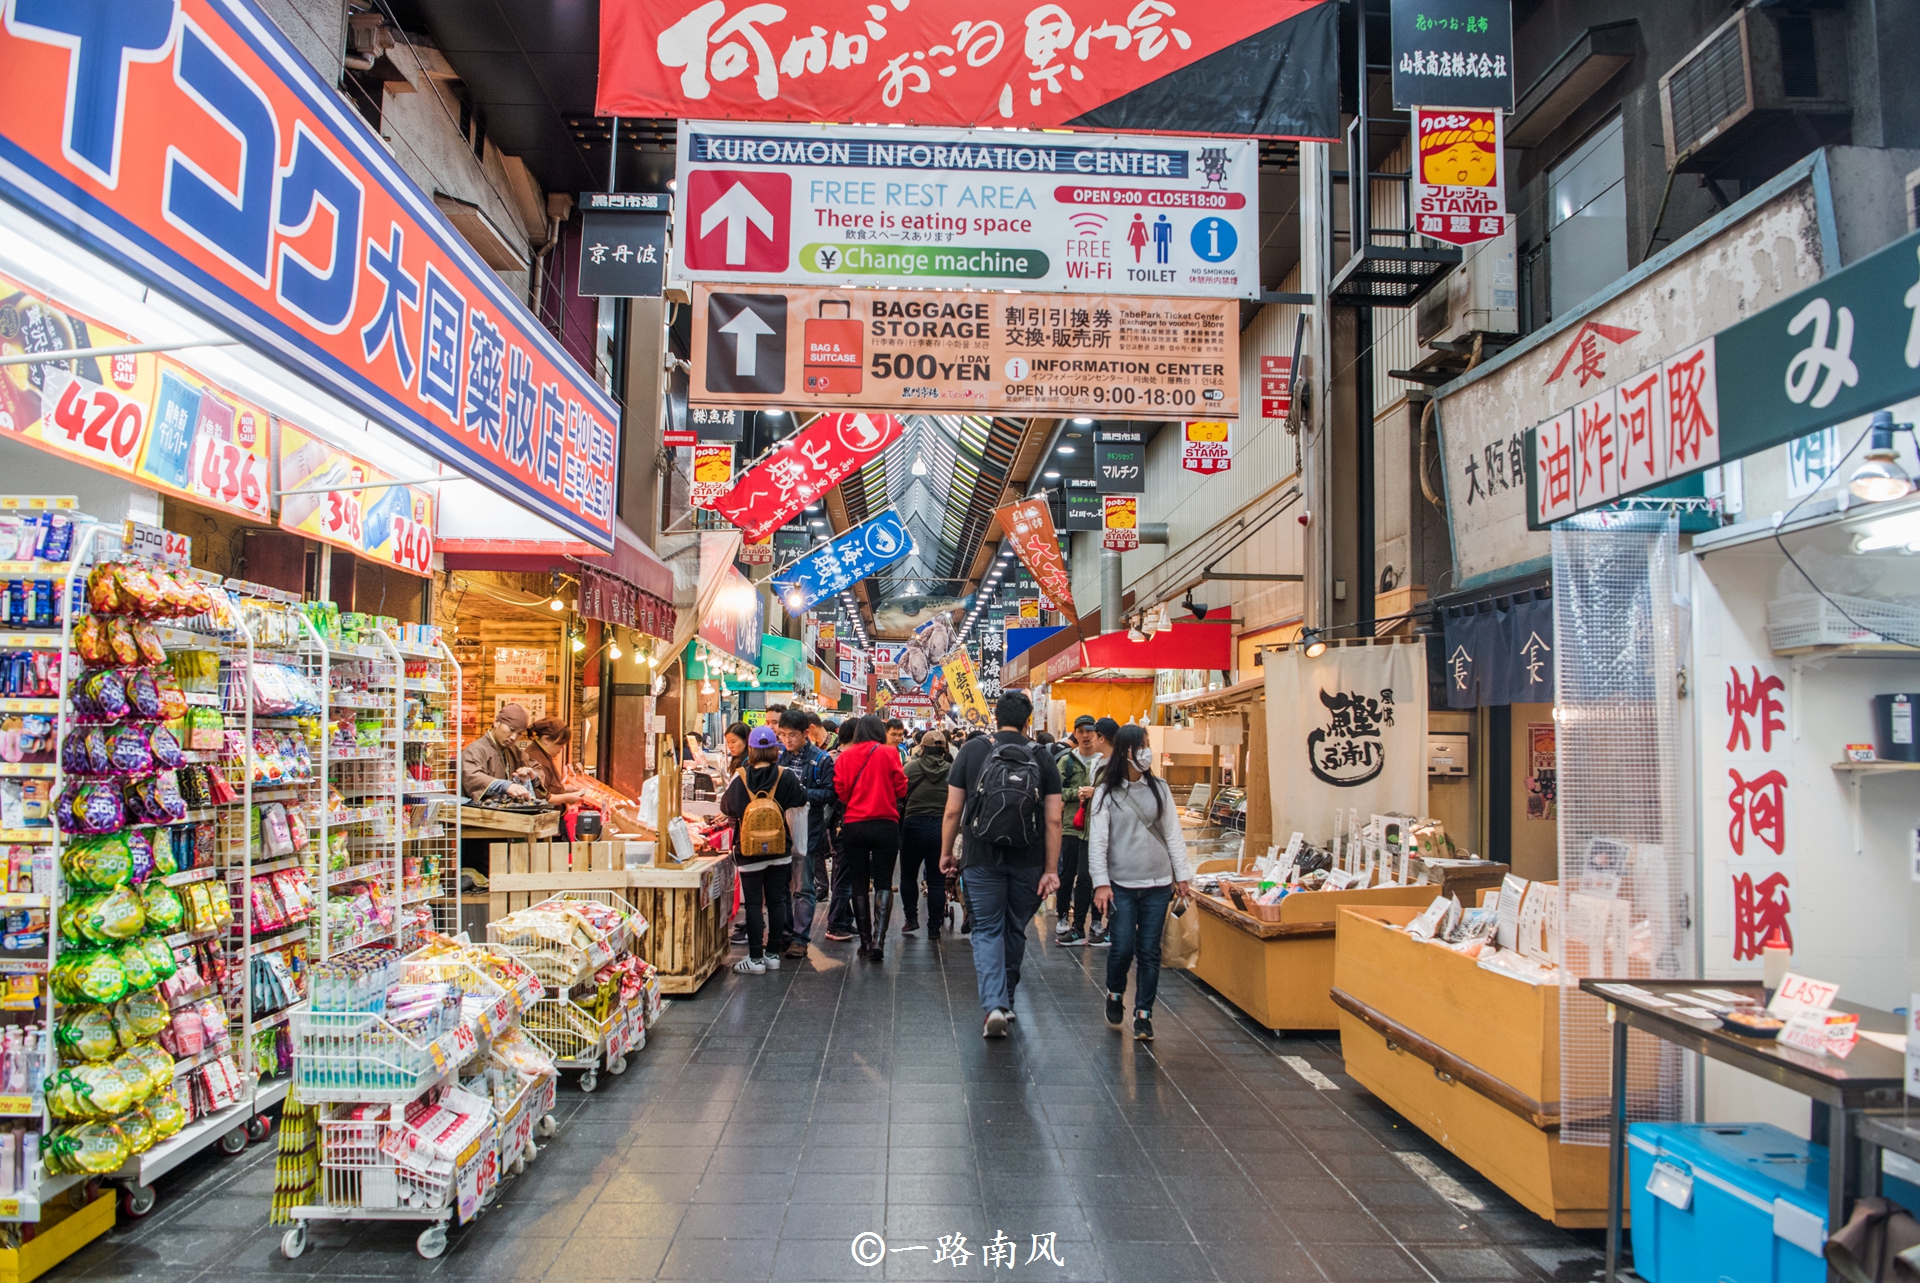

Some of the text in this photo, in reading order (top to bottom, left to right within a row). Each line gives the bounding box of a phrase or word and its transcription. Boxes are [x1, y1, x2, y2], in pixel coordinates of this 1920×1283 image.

[1415, 14, 1489, 33] 花かつお・昆布
[1399, 50, 1507, 79] 山長商店株式会社
[1421, 114, 1471, 133] クロモン
[707, 138, 1171, 176] KUROMON INFORMATION CENTER
[810, 180, 1037, 210] FREE REST AREA
[1073, 188, 1111, 203] OPEN
[1113, 190, 1142, 204] 9:00
[1427, 185, 1489, 199] フレッシュ
[1421, 199, 1498, 214] STAMP
[814, 208, 1032, 236] There is eating space
[1421, 215, 1500, 235] 加盟店
[845, 229, 956, 242] 飲食スペースあります
[588, 243, 658, 265] 京丹波
[1066, 239, 1111, 258] FREE
[845, 248, 929, 274] Change
[935, 251, 1028, 273] machine
[1066, 261, 1112, 279] Wi-Fi
[1127, 268, 1177, 282] TOILET
[1203, 268, 1236, 276] SMOKING
[872, 300, 989, 319] BAGGAGE
[1005, 305, 1113, 329] 割引引換券
[1119, 310, 1224, 321] TabePark Ticket Center
[871, 321, 990, 340] STORAGE
[1119, 319, 1157, 327] (Exchange
[1168, 320, 1200, 328] voucher)
[1784, 243, 1920, 409] み
[1005, 327, 1112, 349] 交換・販売所
[810, 343, 840, 352] BAG &
[116, 362, 133, 372] ON
[810, 353, 856, 363] SUITCASE
[967, 355, 990, 363] DAY
[1031, 358, 1224, 376] INFORMATION CENTER
[1032, 372, 1123, 381] インフォメーションセンター
[1201, 377, 1225, 386] 안내소
[1004, 385, 1043, 397] OPEN
[1049, 386, 1089, 397] HOUR
[54, 379, 142, 459] 420
[243, 426, 254, 434] ON
[1538, 347, 1715, 518] 油炸河豚
[696, 448, 719, 457] クロモン
[1186, 449, 1228, 457] STAMP
[1102, 465, 1139, 478] マルチク
[1186, 458, 1229, 469] 加盟店
[201, 437, 261, 510] 436
[1106, 499, 1126, 507] クロモン
[327, 490, 360, 541] 398
[165, 533, 187, 558] 84
[393, 517, 431, 572] 340
[523, 658, 540, 666] Frui
[1725, 665, 1794, 961] 炸河豚
[1780, 977, 1835, 1005] LAST
